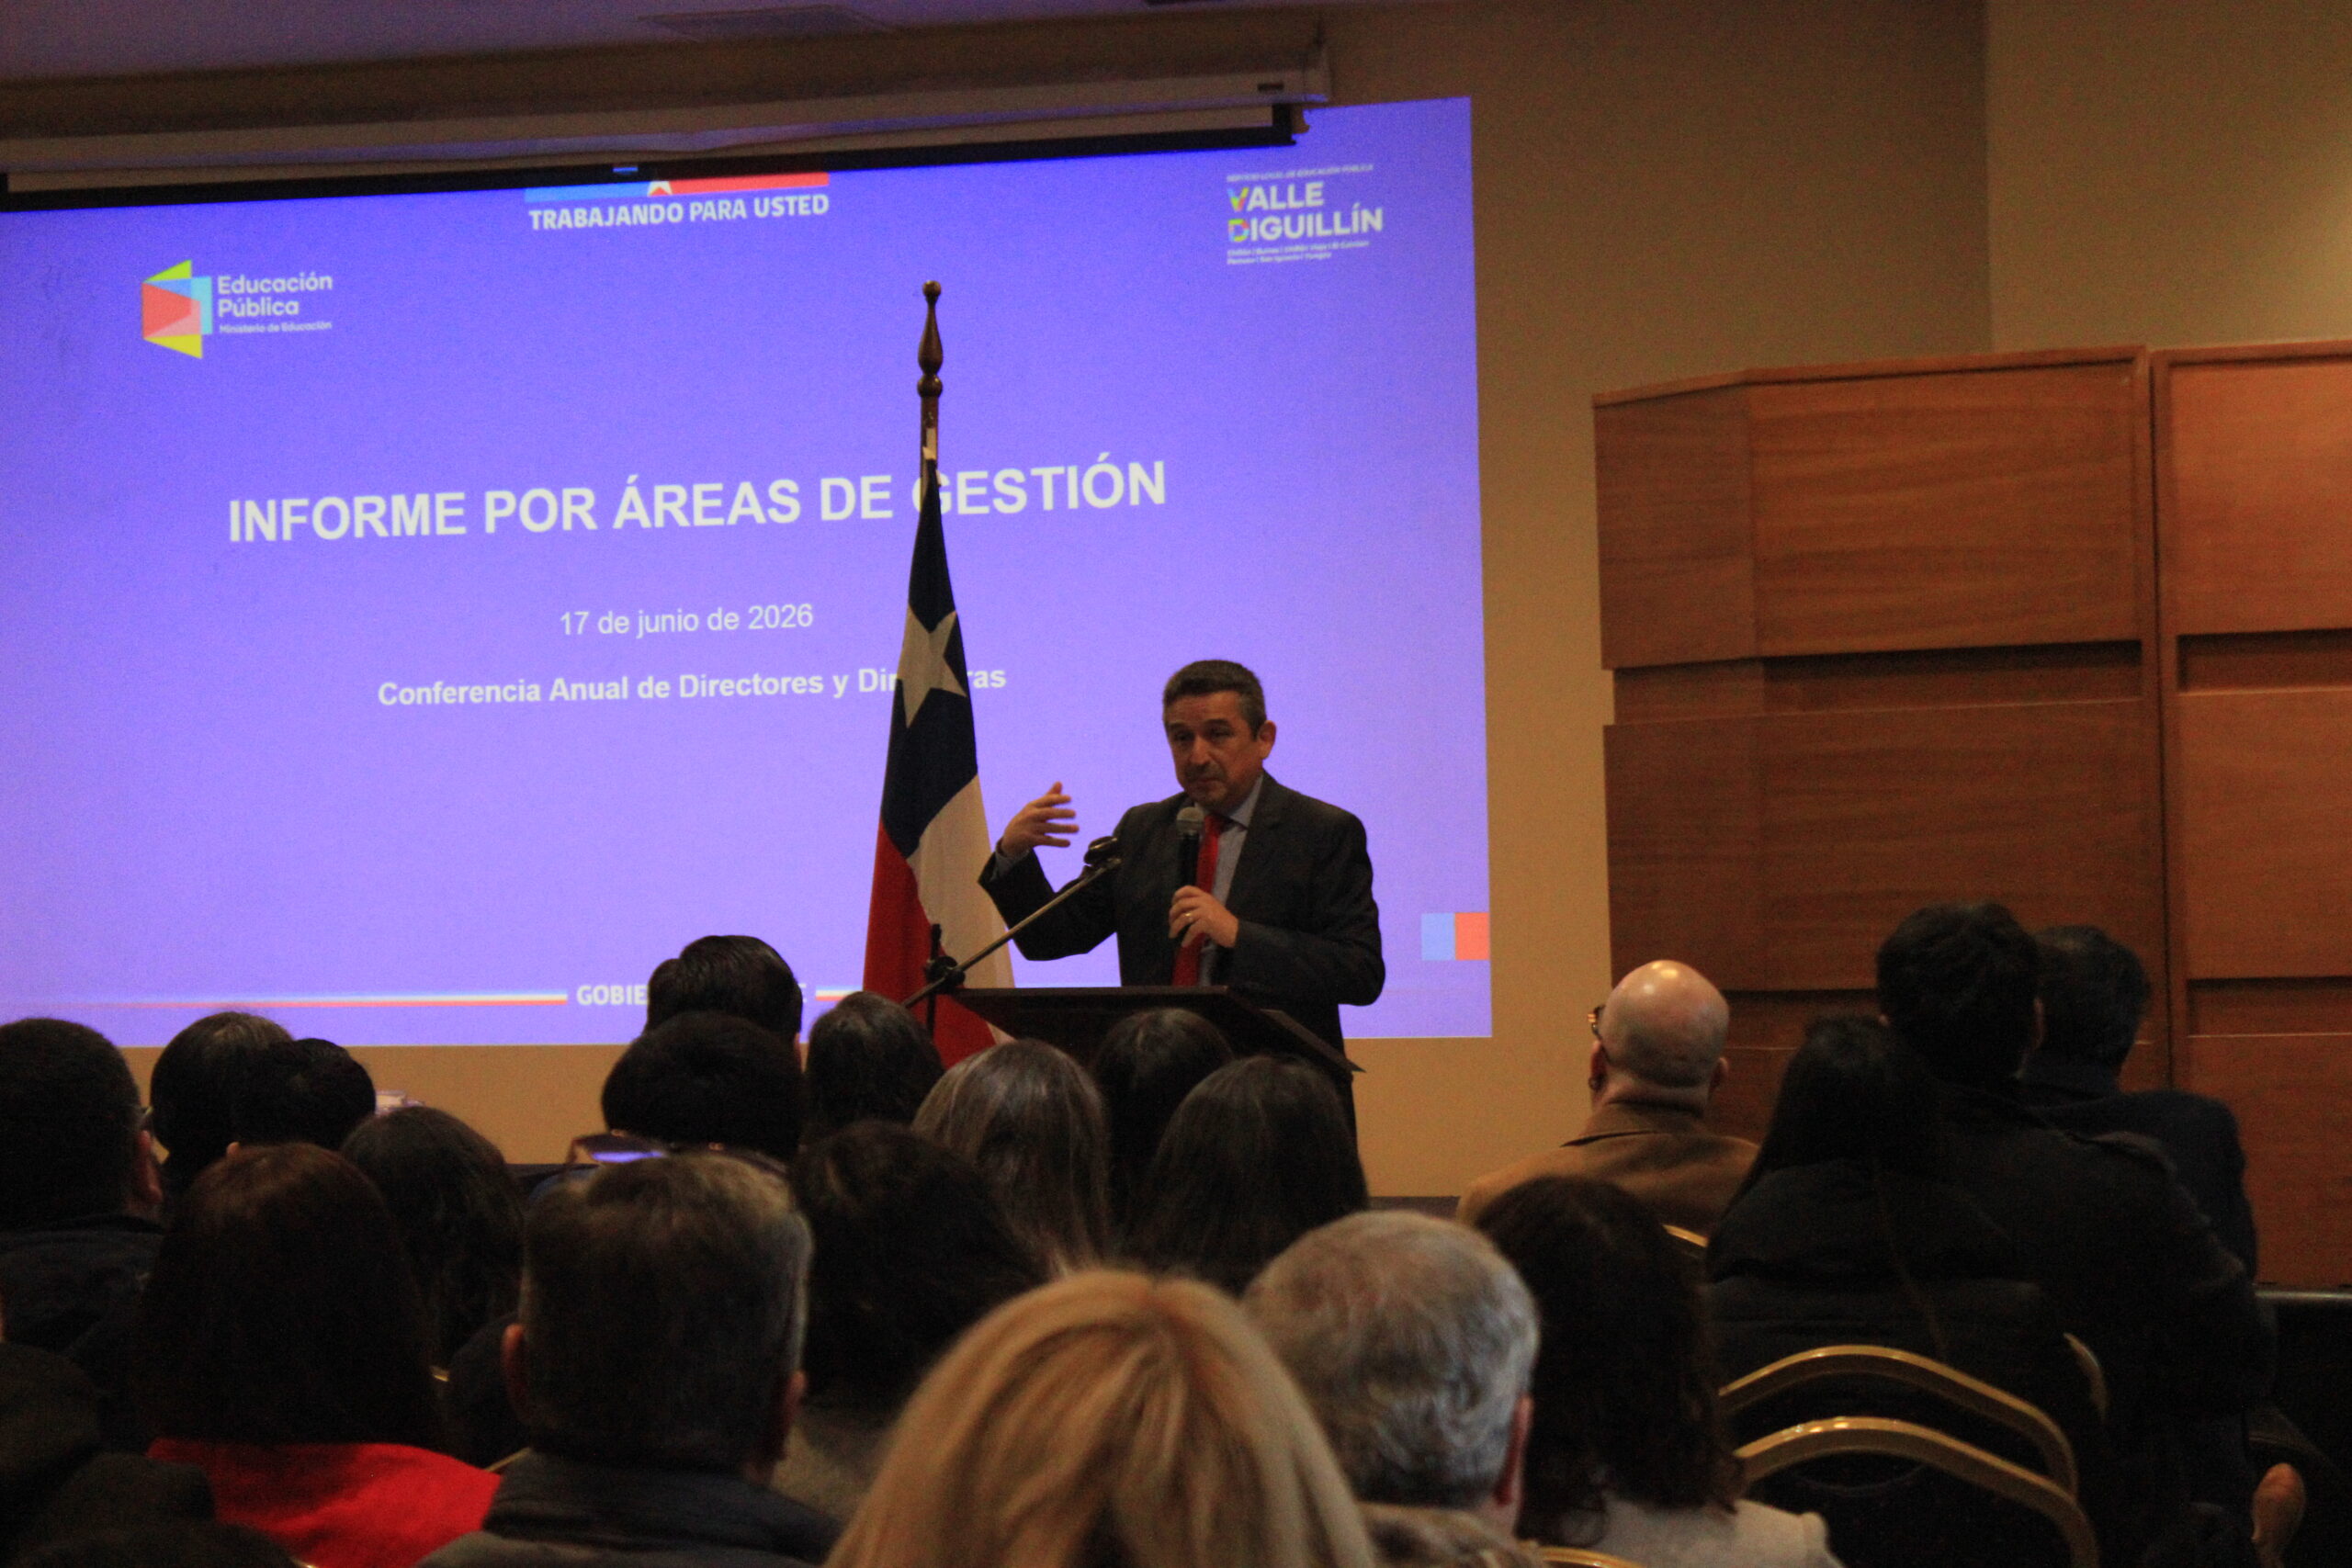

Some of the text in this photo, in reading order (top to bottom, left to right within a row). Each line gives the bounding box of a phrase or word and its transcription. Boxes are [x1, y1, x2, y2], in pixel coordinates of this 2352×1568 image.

[529, 194, 829, 231] TRABAJANDO PARA USTED
[1227, 181, 1324, 212] VALLE
[1227, 202, 1383, 242] DIGUILLÍN
[218, 272, 333, 295] Educación
[218, 298, 300, 318] Pública
[230, 491, 467, 542] INFORME
[484, 487, 598, 533] POR
[613, 474, 801, 527] ÁREAS
[820, 474, 893, 522] DE
[560, 604, 813, 639] 17 de junio de 2026
[379, 668, 1007, 705] Conferencia Anual de Directores y Diras
[576, 985, 649, 1006] GOBIE
